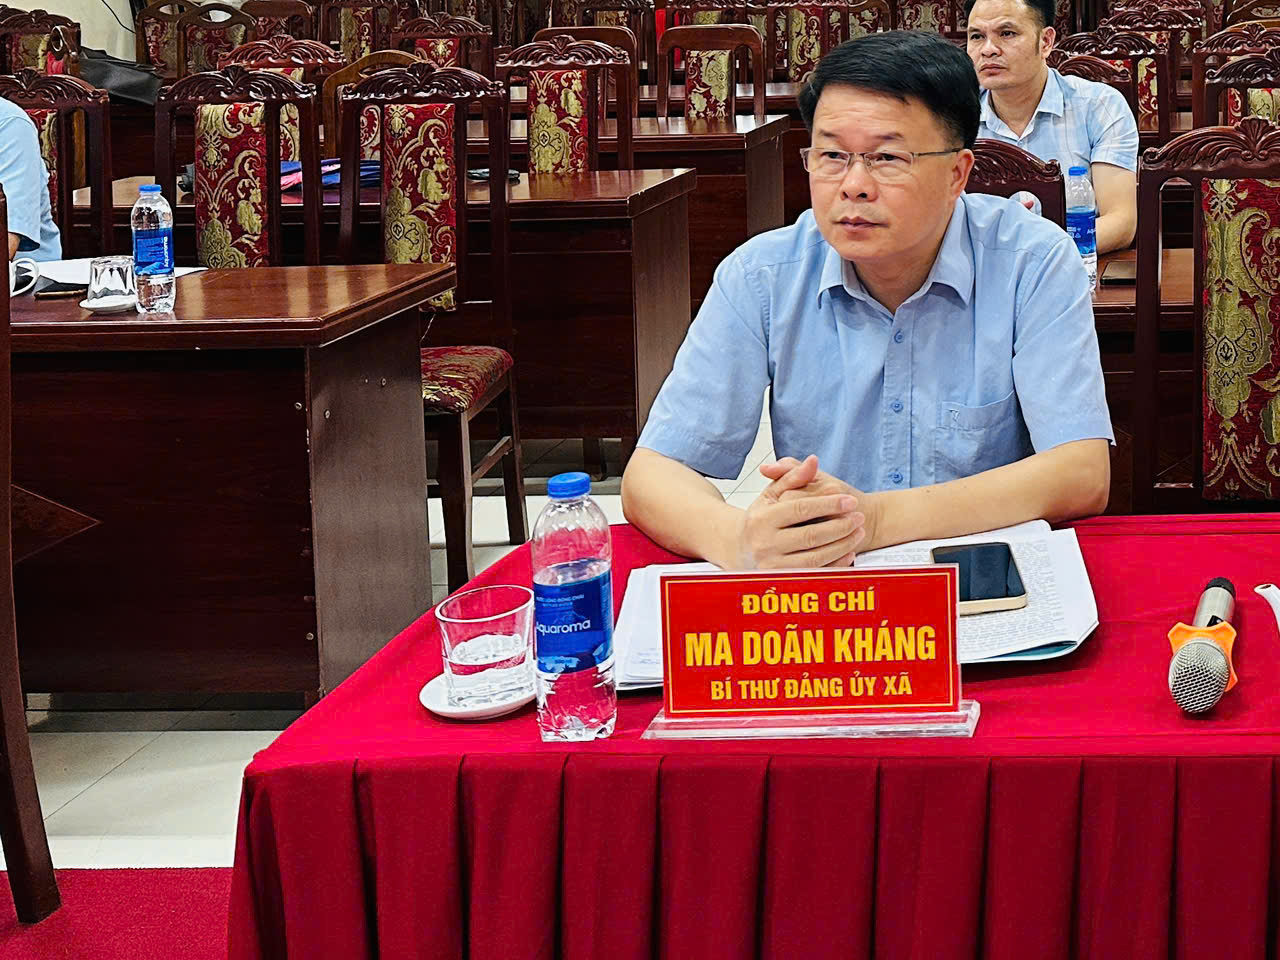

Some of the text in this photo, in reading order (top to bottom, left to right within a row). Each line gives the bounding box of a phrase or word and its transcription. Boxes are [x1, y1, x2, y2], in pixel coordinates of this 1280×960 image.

[741, 586, 875, 614] ĐỒNG CHÍ
[685, 619, 936, 666] MA DOÃN KHÁNG
[711, 671, 913, 701] BÍ THƯ ĐẢNG ỦY XÃ
